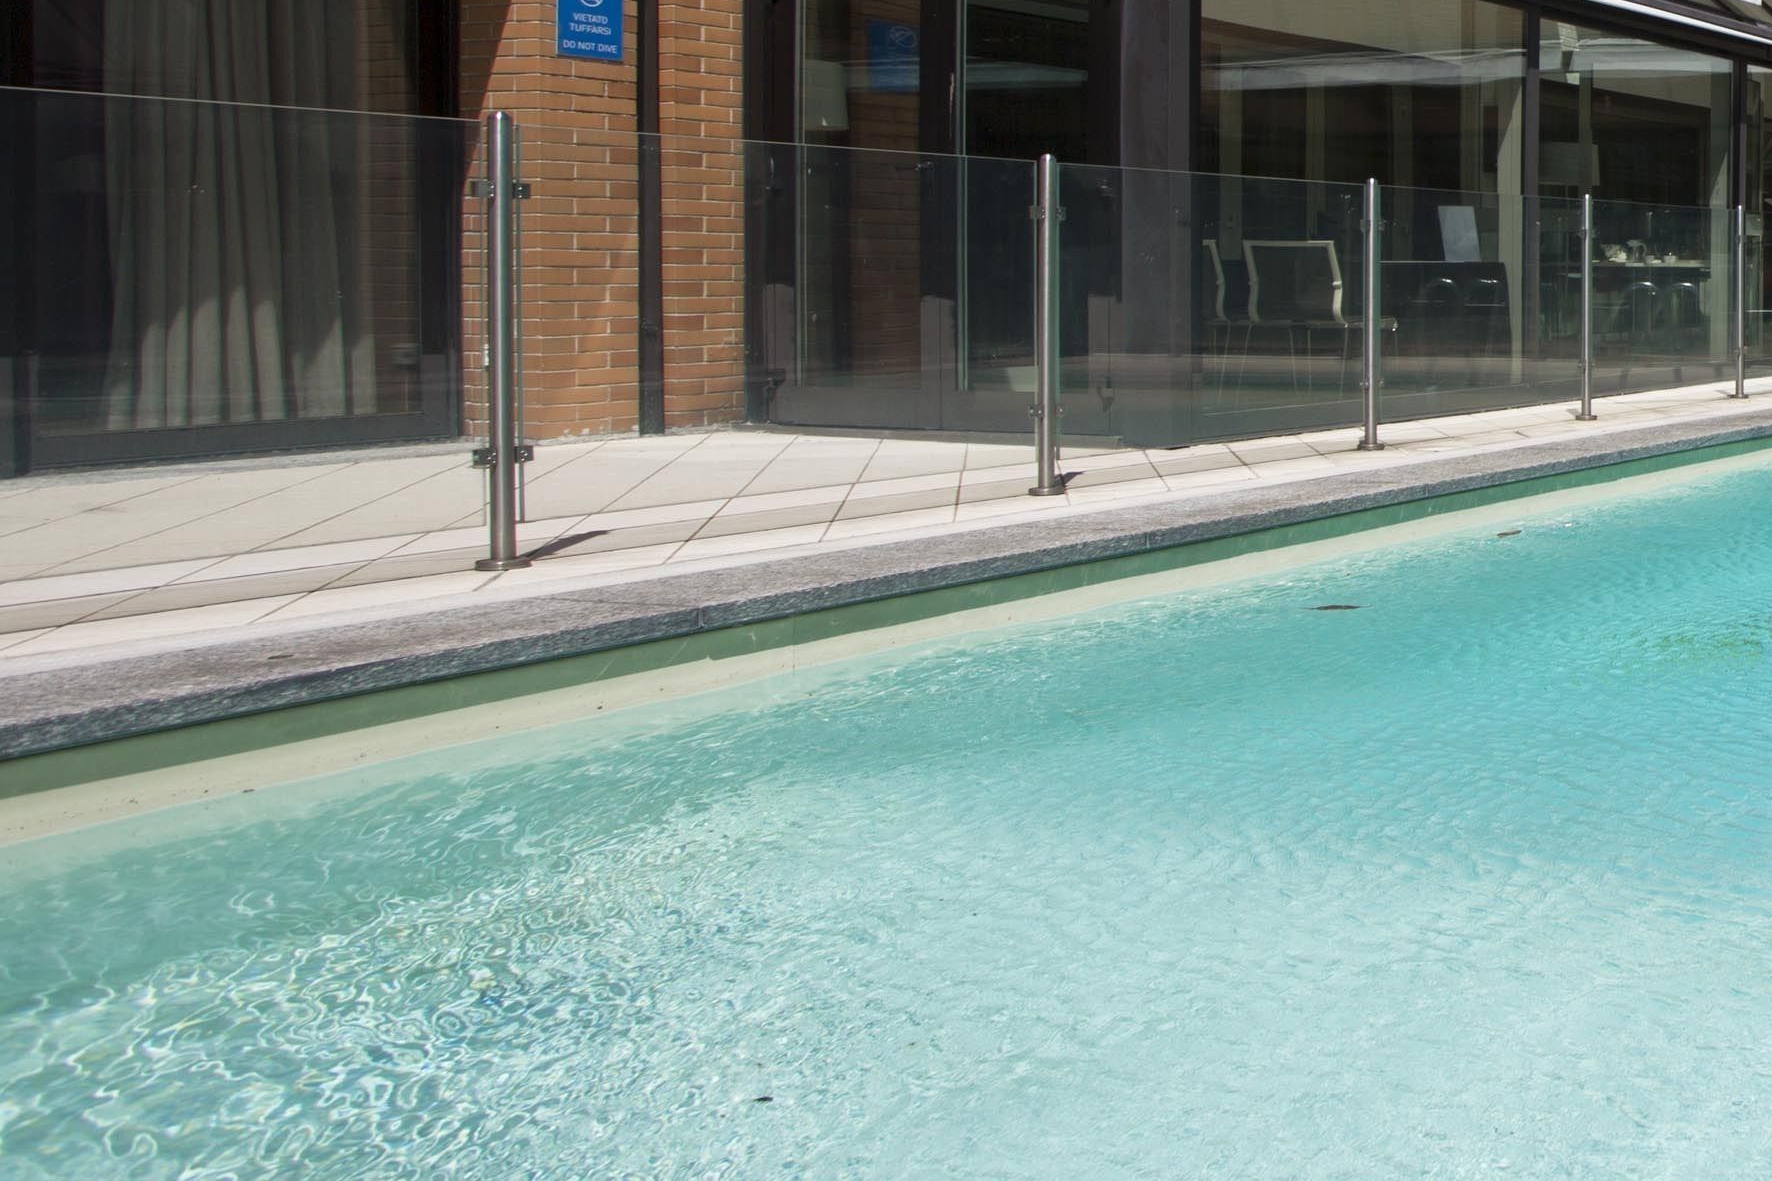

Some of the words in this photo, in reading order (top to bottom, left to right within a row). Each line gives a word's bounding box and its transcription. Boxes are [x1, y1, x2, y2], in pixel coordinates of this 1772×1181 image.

[573, 12, 609, 24] VIETATO
[569, 23, 612, 35] TUFFARSI
[563, 39, 576, 49] DO
[577, 41, 595, 51] NOT
[598, 43, 618, 54] DIVE
